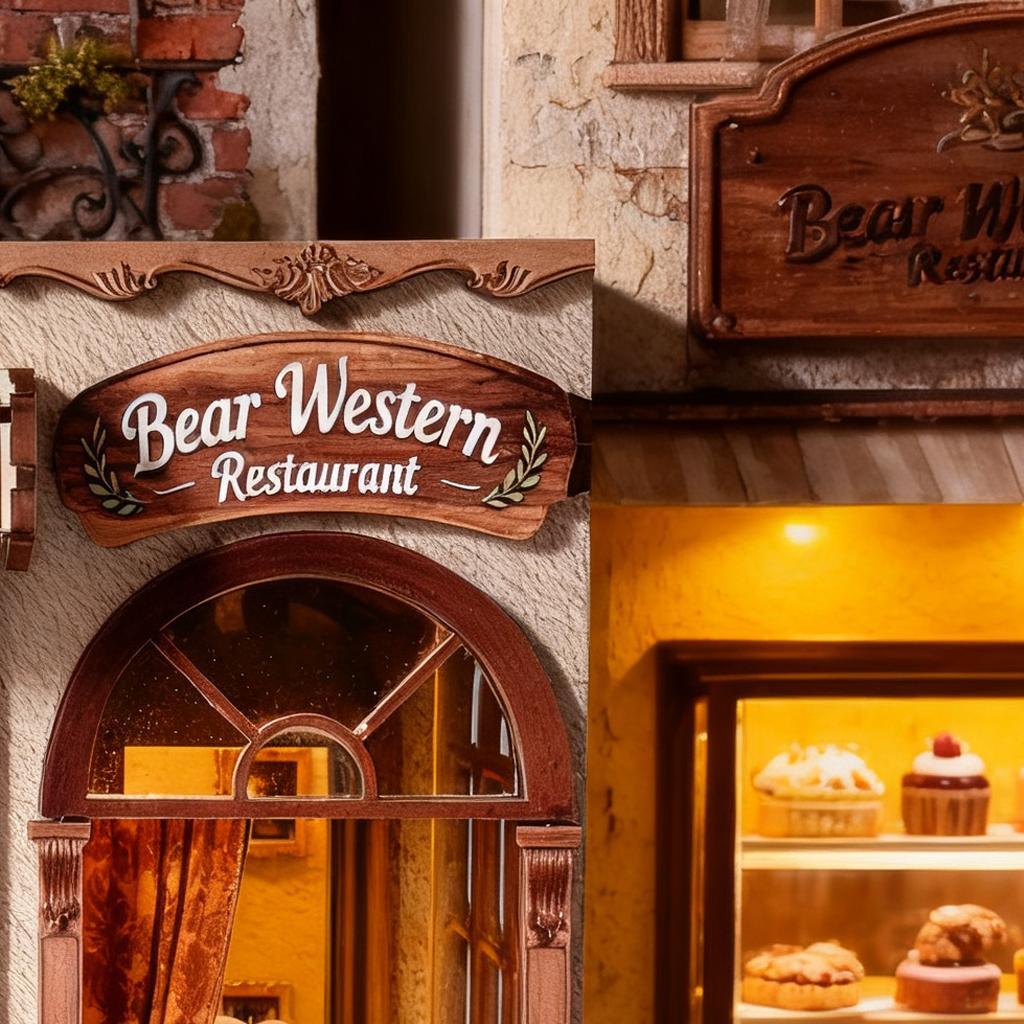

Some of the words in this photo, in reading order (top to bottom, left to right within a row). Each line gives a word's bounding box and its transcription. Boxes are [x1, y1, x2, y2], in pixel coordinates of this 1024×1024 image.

[779, 184, 943, 263] Bear
[121, 393, 262, 476] Bear
[275, 356, 502, 464] Western
[211, 451, 422, 503] Restaurant
